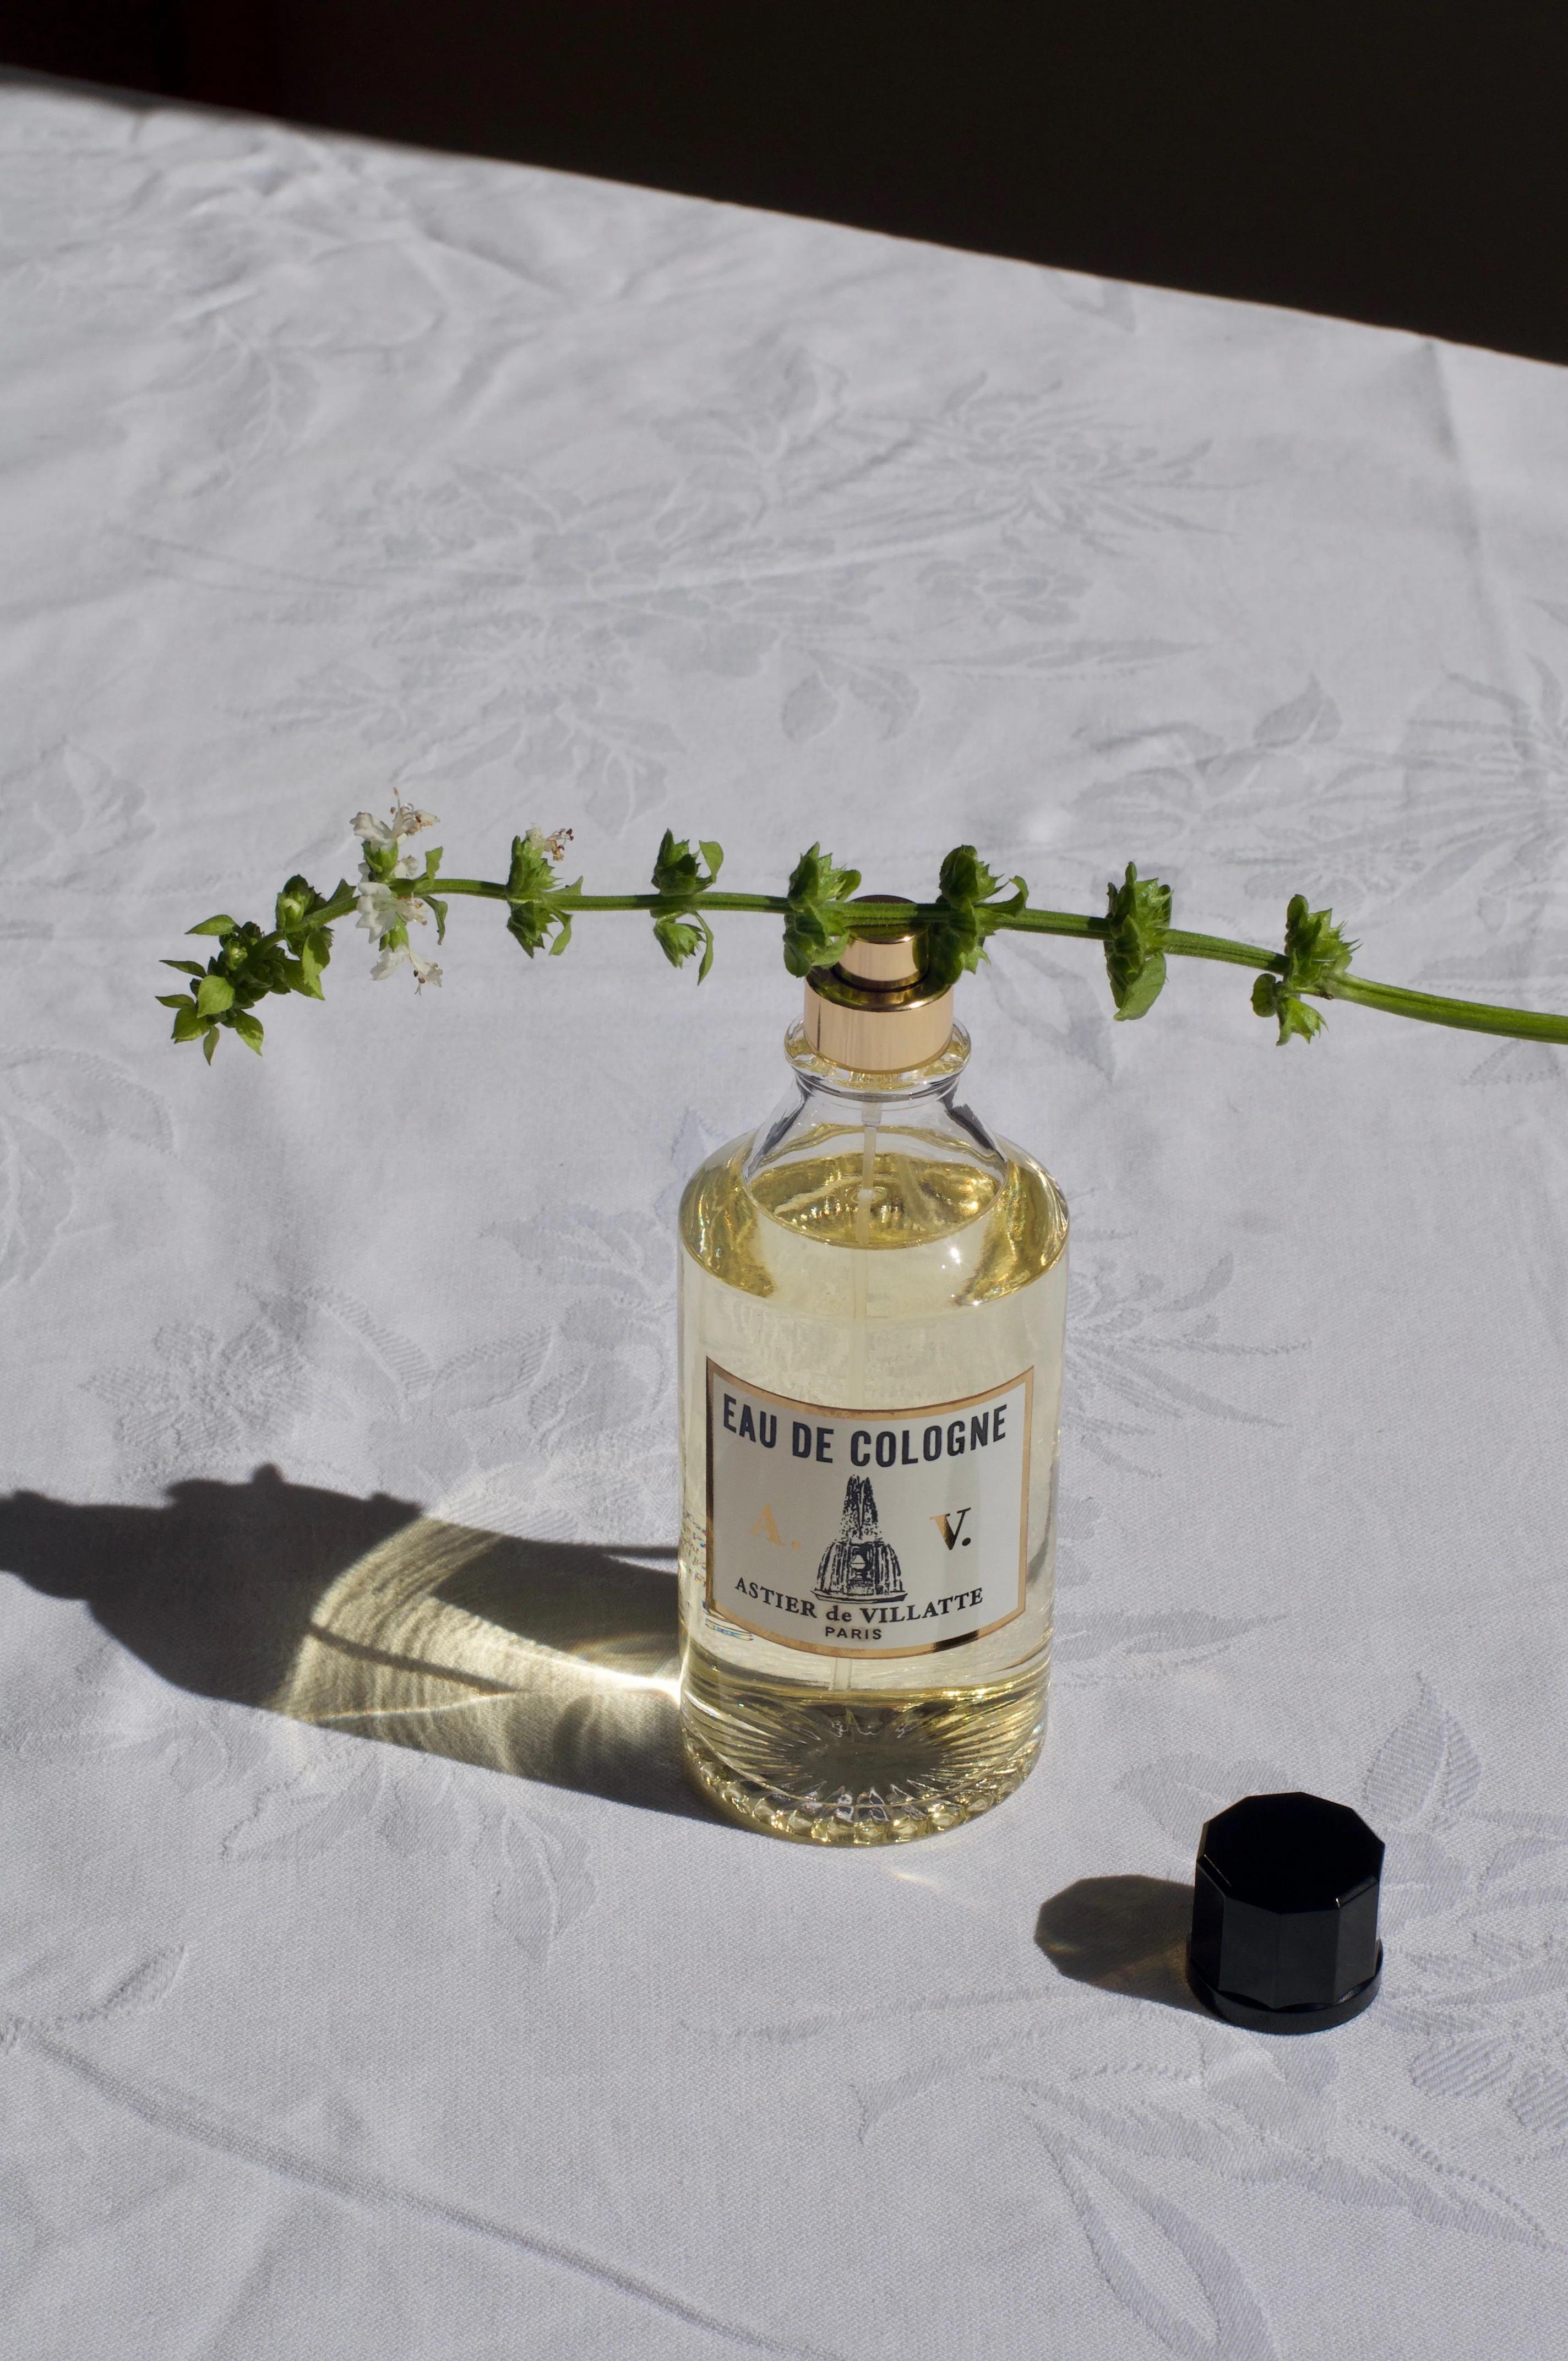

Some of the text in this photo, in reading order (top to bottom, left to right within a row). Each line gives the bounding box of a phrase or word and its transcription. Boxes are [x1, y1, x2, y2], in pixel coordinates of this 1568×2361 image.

[723, 1393, 1008, 1467] EAU DE COLOGNE
[930, 1507, 971, 1551] V.
[735, 1577, 983, 1624] ASTIER de VILLATTE
[825, 1626, 882, 1640] PARIS
